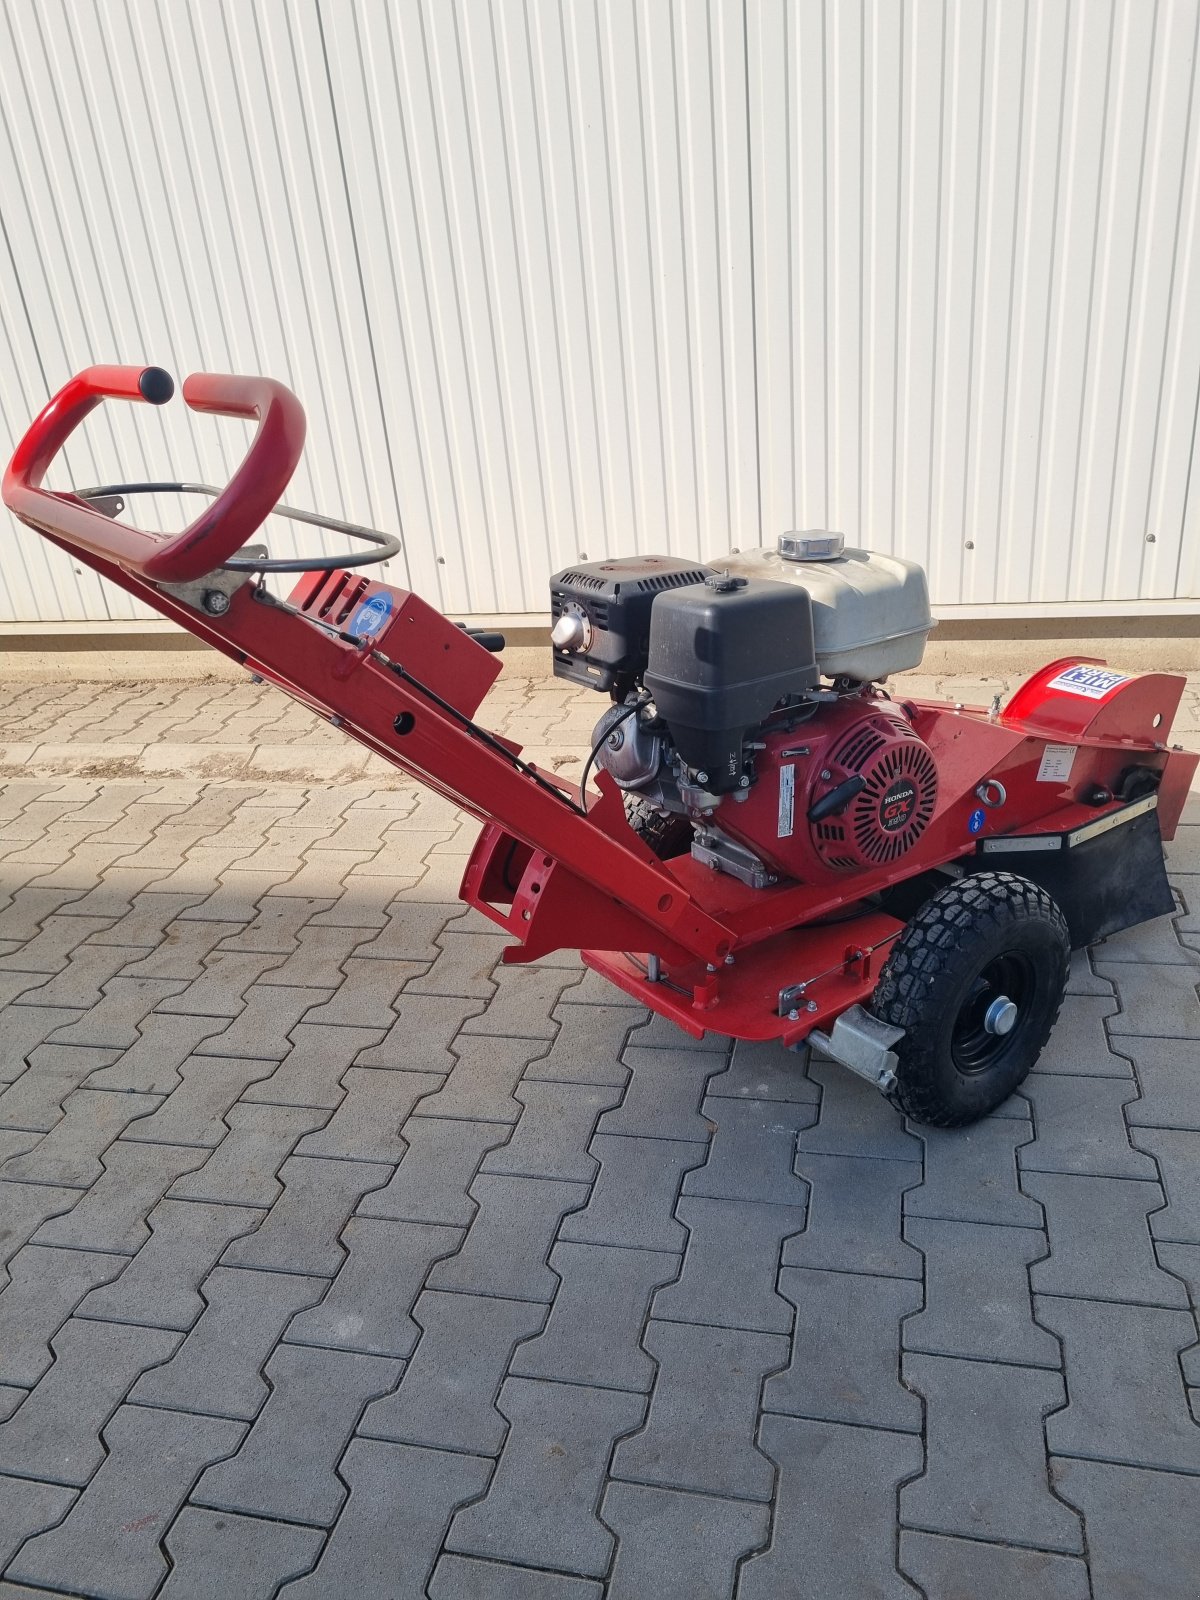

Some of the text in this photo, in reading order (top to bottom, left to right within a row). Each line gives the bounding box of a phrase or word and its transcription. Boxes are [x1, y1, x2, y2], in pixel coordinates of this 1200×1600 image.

[1062, 672, 1115, 689] MIET
[885, 789, 914, 804] HONDA
[885, 798, 912, 818] GX
